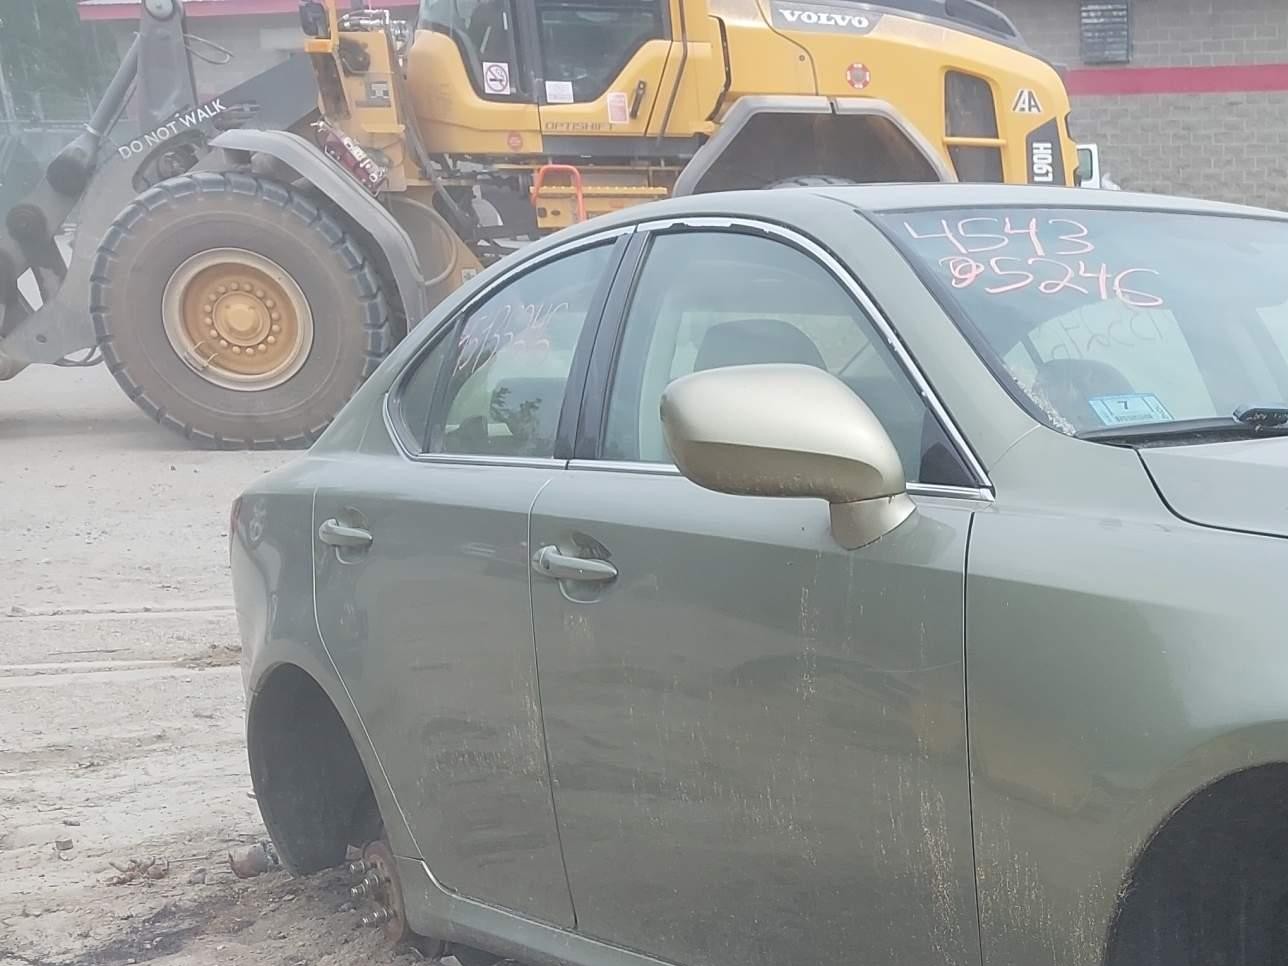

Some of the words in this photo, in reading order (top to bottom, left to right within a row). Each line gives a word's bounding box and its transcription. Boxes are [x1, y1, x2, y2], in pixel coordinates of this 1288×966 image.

[779, 9, 870, 28] VOLVO
[119, 141, 143, 159] DO
[144, 121, 178, 146] NOT
[179, 99, 227, 127] WALK
[1032, 142, 1053, 182] L90H
[904, 217, 1094, 256] 4543
